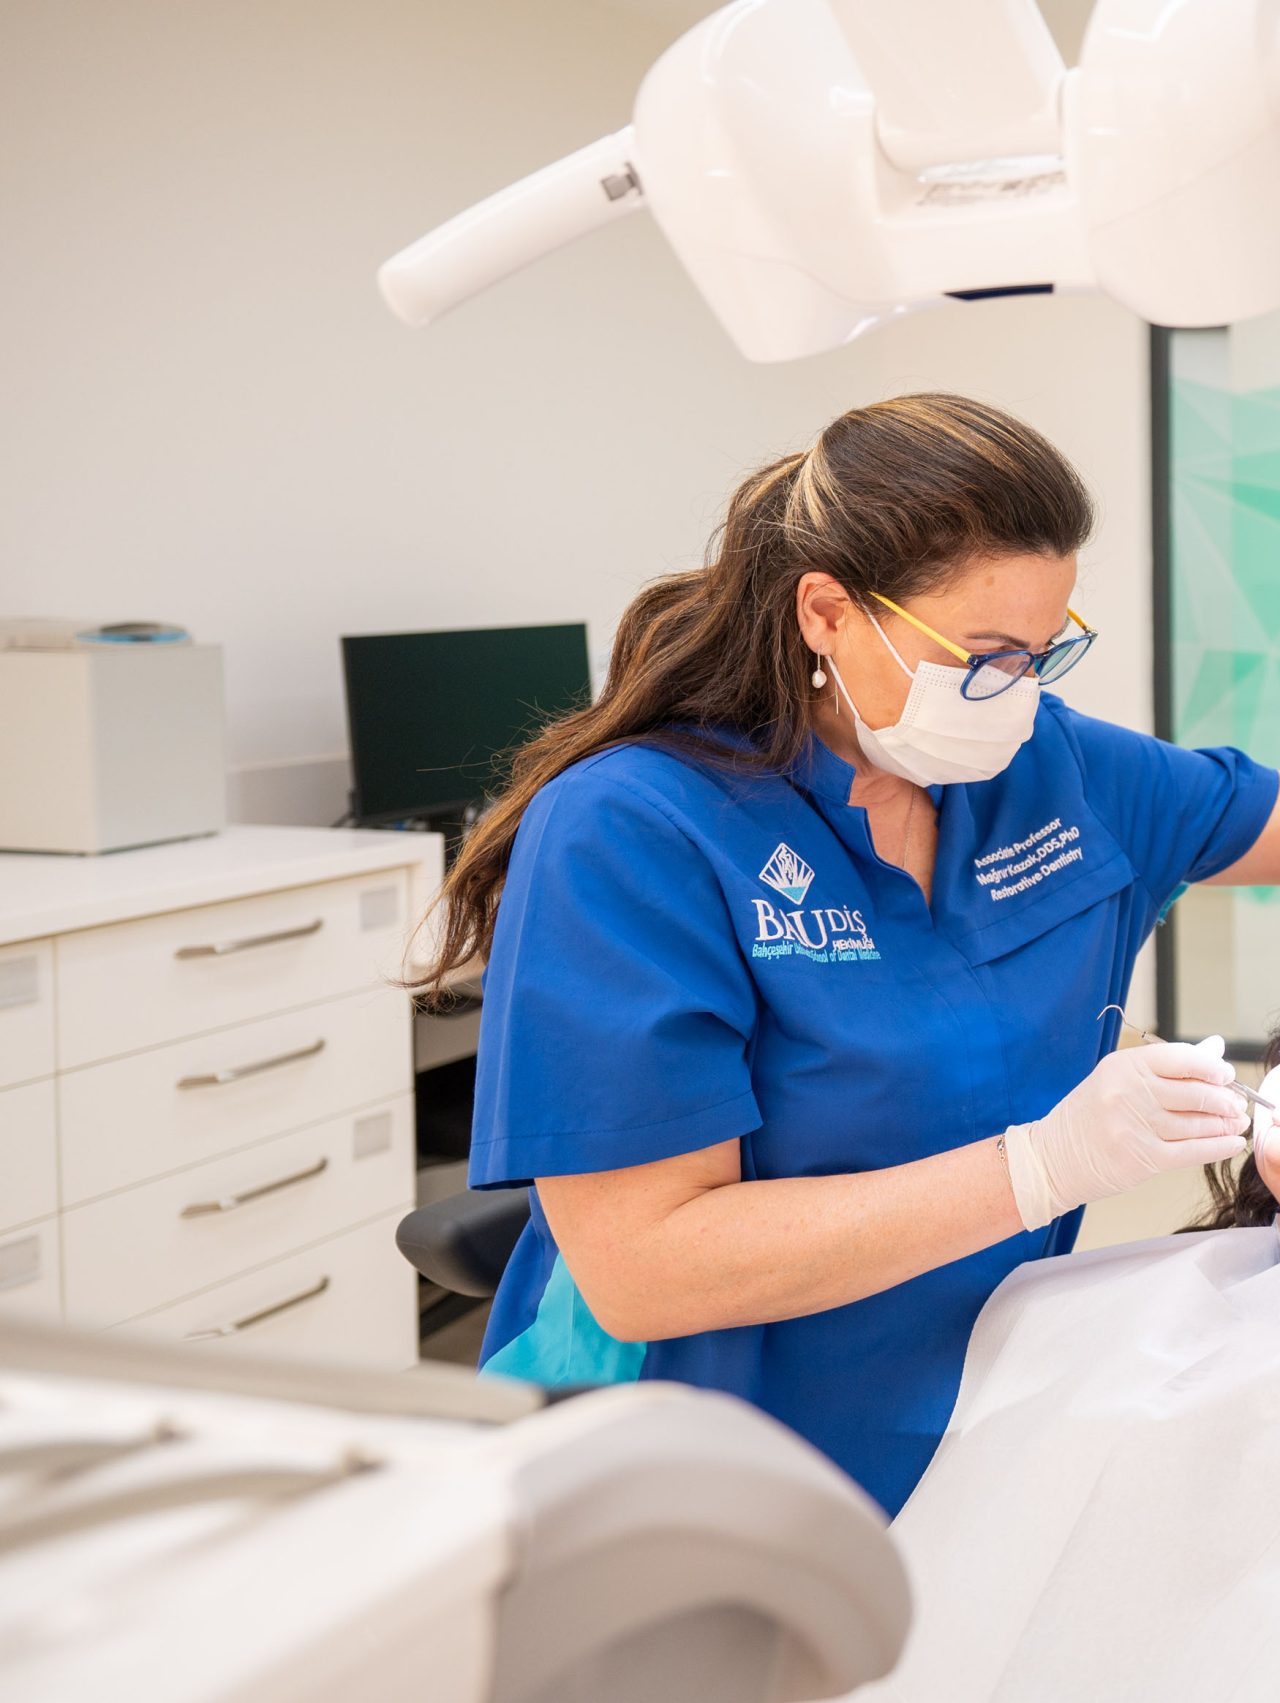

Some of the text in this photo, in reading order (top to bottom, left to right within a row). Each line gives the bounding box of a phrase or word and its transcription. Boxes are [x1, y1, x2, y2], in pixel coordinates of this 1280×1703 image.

[1012, 817, 1062, 854] Professor
[990, 846, 1083, 902] Restorative Dentistry
